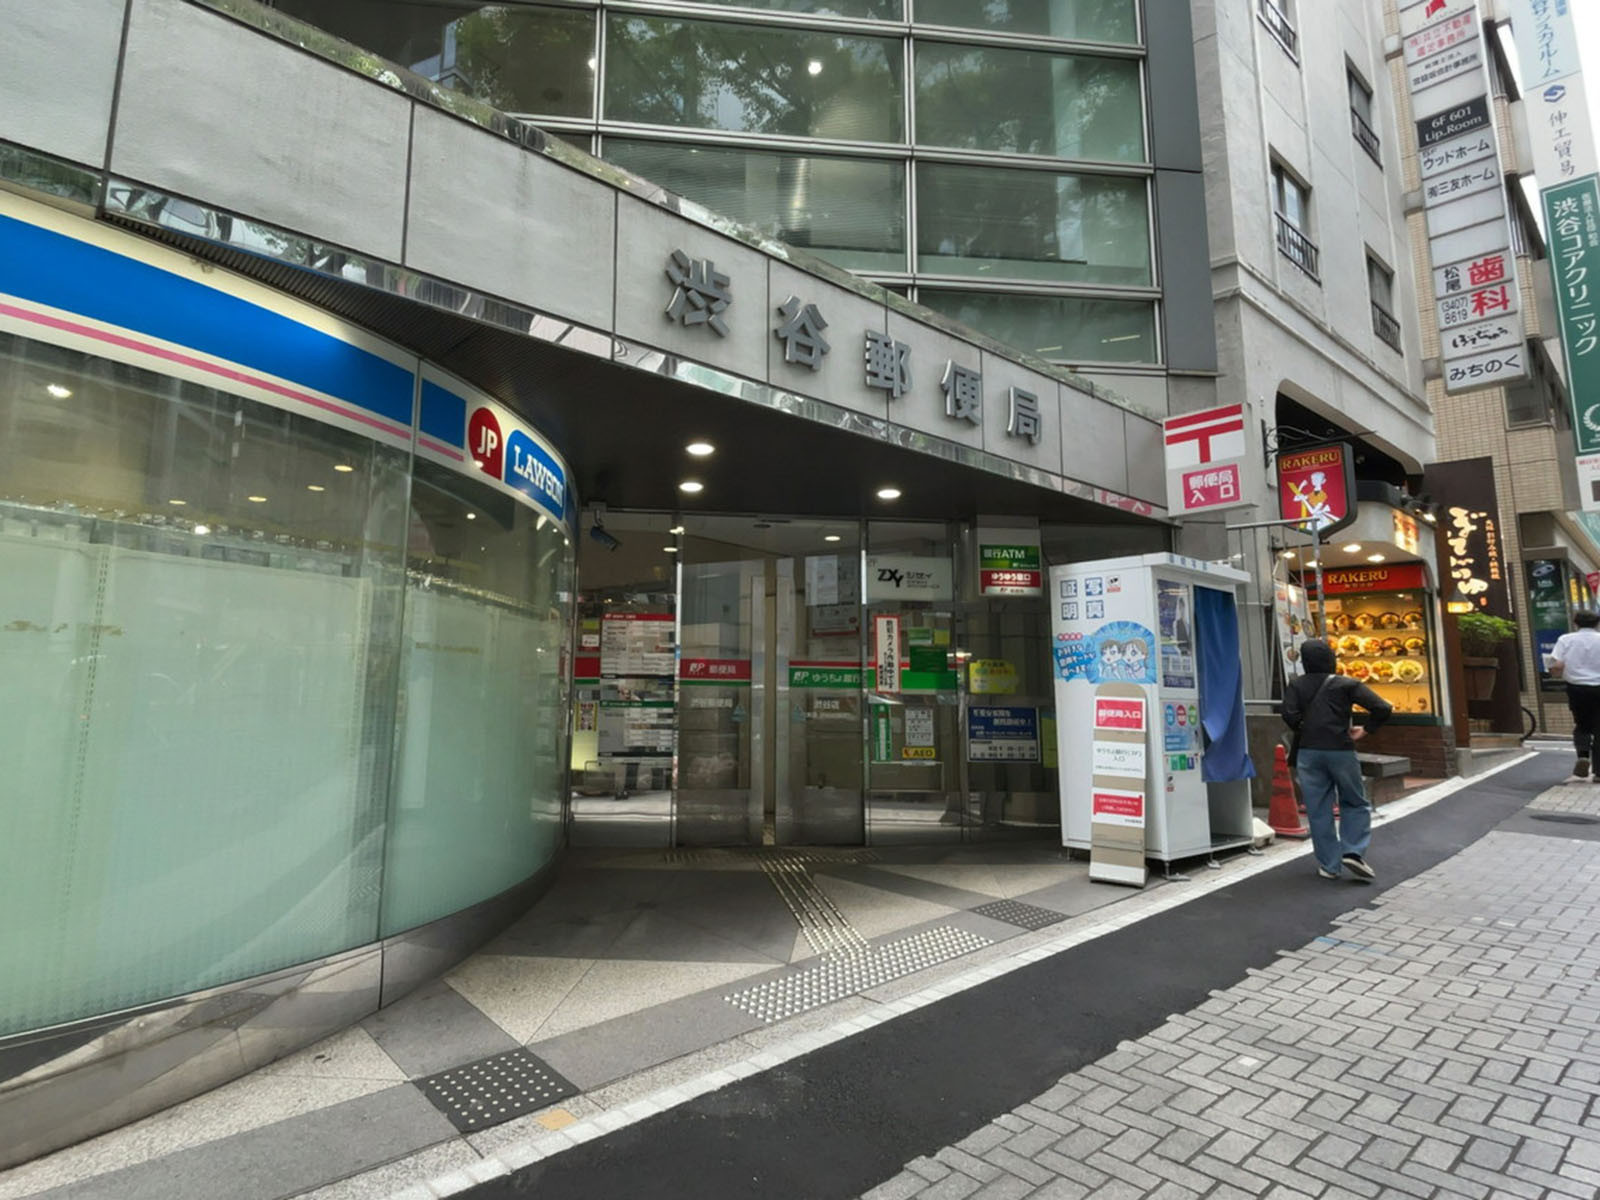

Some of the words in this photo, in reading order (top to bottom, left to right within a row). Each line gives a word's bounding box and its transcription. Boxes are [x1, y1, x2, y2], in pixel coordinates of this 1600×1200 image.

[1431, 114, 1447, 128] 6F
[1449, 106, 1472, 121] 601
[1443, 266, 1462, 293] 松尾
[1467, 255, 1511, 317] 歯科
[1553, 196, 1598, 356] 渋谷コアクリニック
[665, 248, 1042, 446] 渋谷郵便局
[1449, 354, 1521, 381] みちのく
[477, 426, 498, 458] JP
[1281, 451, 1338, 470] RAKERU
[513, 445, 564, 508] LAWSON
[1189, 470, 1233, 490] 郵便局
[1191, 484, 1235, 504] 入口
[878, 568, 905, 588] ZXY
[1328, 570, 1389, 585] RAKERU
[812, 673, 860, 683] ゆうちょ銀行
